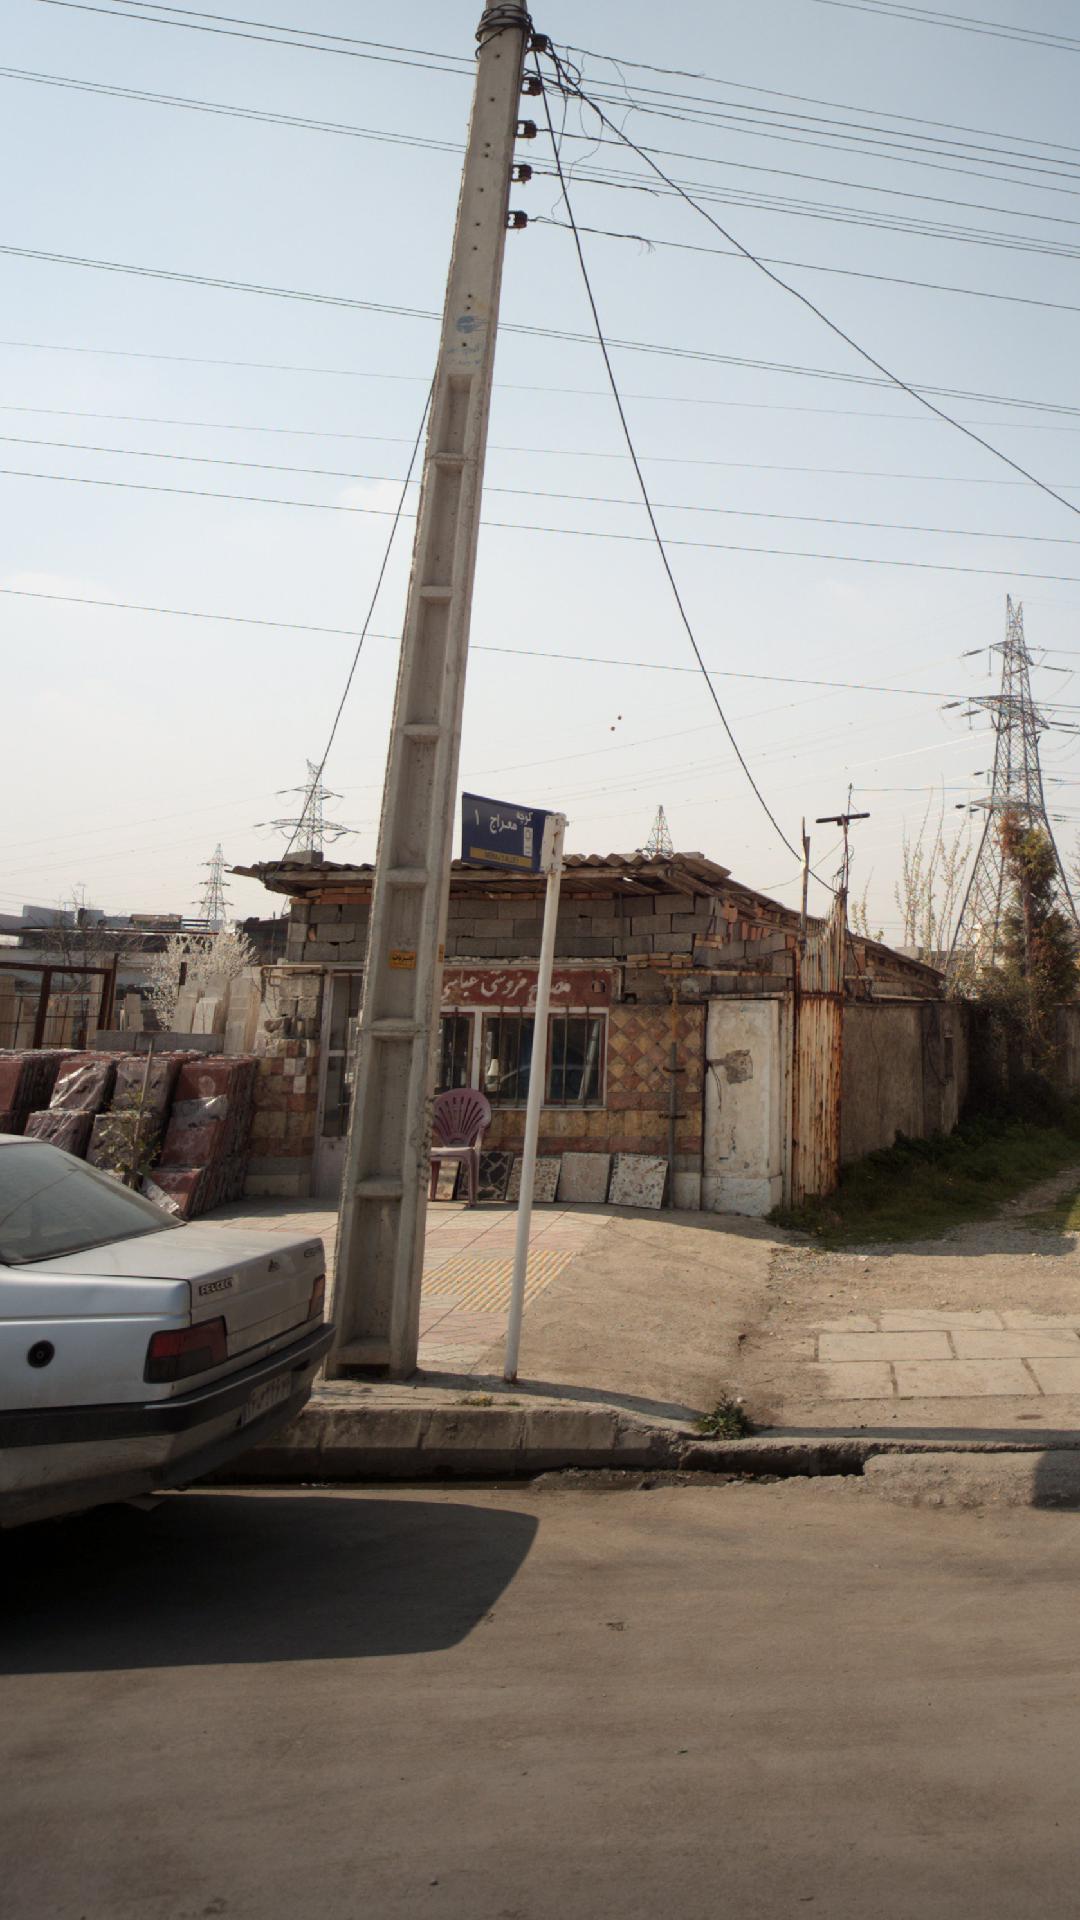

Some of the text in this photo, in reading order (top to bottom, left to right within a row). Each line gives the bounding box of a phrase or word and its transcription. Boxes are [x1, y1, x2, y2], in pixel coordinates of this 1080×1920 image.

[490, 814, 517, 834] معراج
[481, 970, 527, 998] فروشی
[528, 981, 571, 1006] مصح
